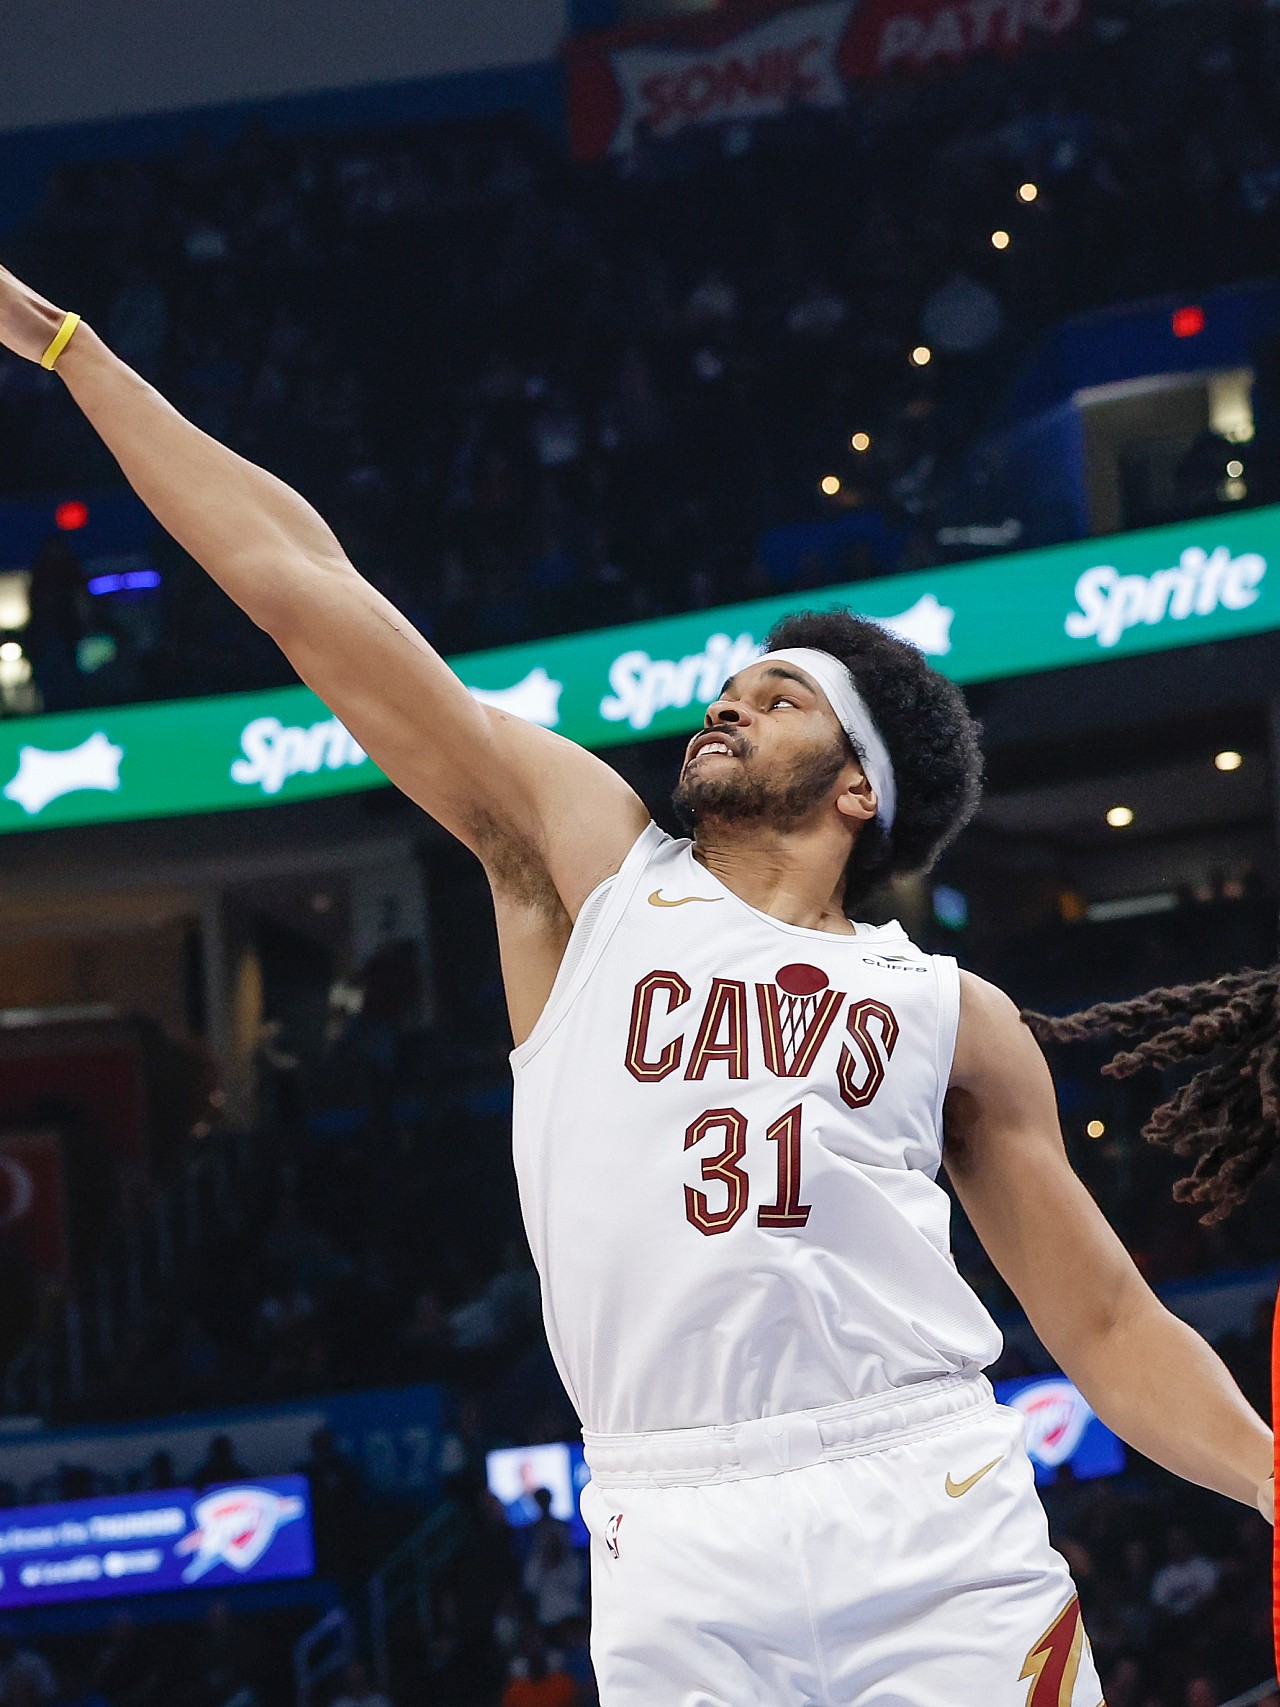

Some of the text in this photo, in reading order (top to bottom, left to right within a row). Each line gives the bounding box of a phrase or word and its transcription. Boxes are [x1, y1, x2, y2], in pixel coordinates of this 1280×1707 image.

[1064, 545, 1268, 648] Sprite
[862, 957, 928, 974] CLIFFS
[624, 963, 900, 1110] CAVS
[683, 1103, 812, 1237] 31
